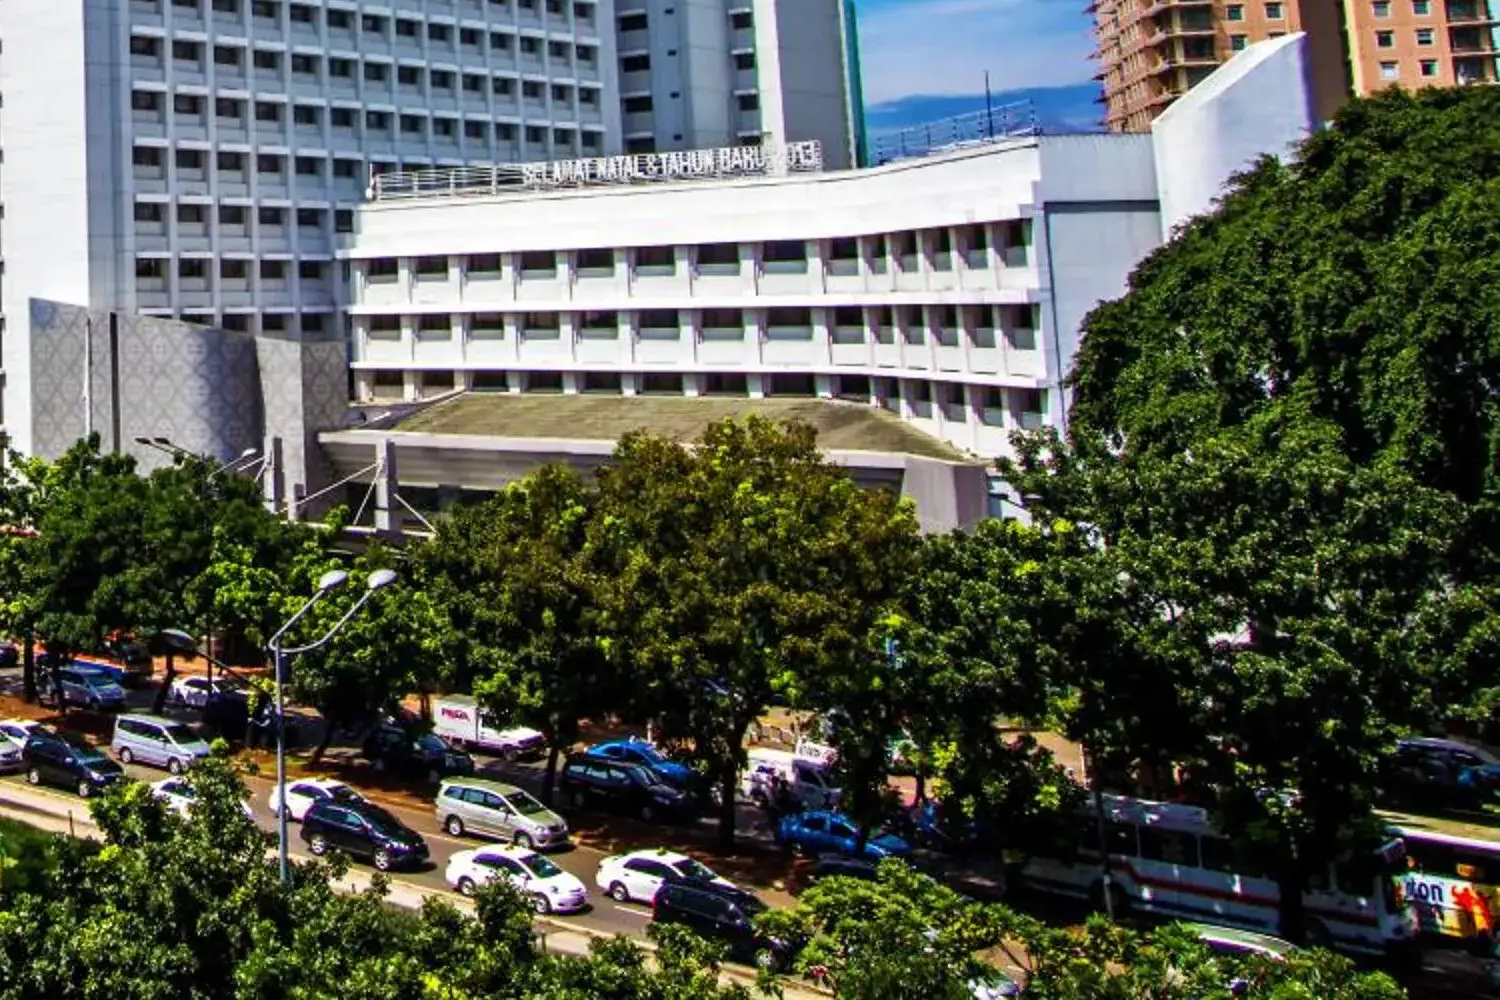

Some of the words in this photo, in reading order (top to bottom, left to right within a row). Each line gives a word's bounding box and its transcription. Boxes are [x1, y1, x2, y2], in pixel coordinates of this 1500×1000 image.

[523, 158, 591, 185] SELAMAT
[596, 154, 645, 180] NATAL
[646, 153, 657, 177] &
[657, 149, 715, 177] TAHUN
[719, 145, 766, 171] BARU
